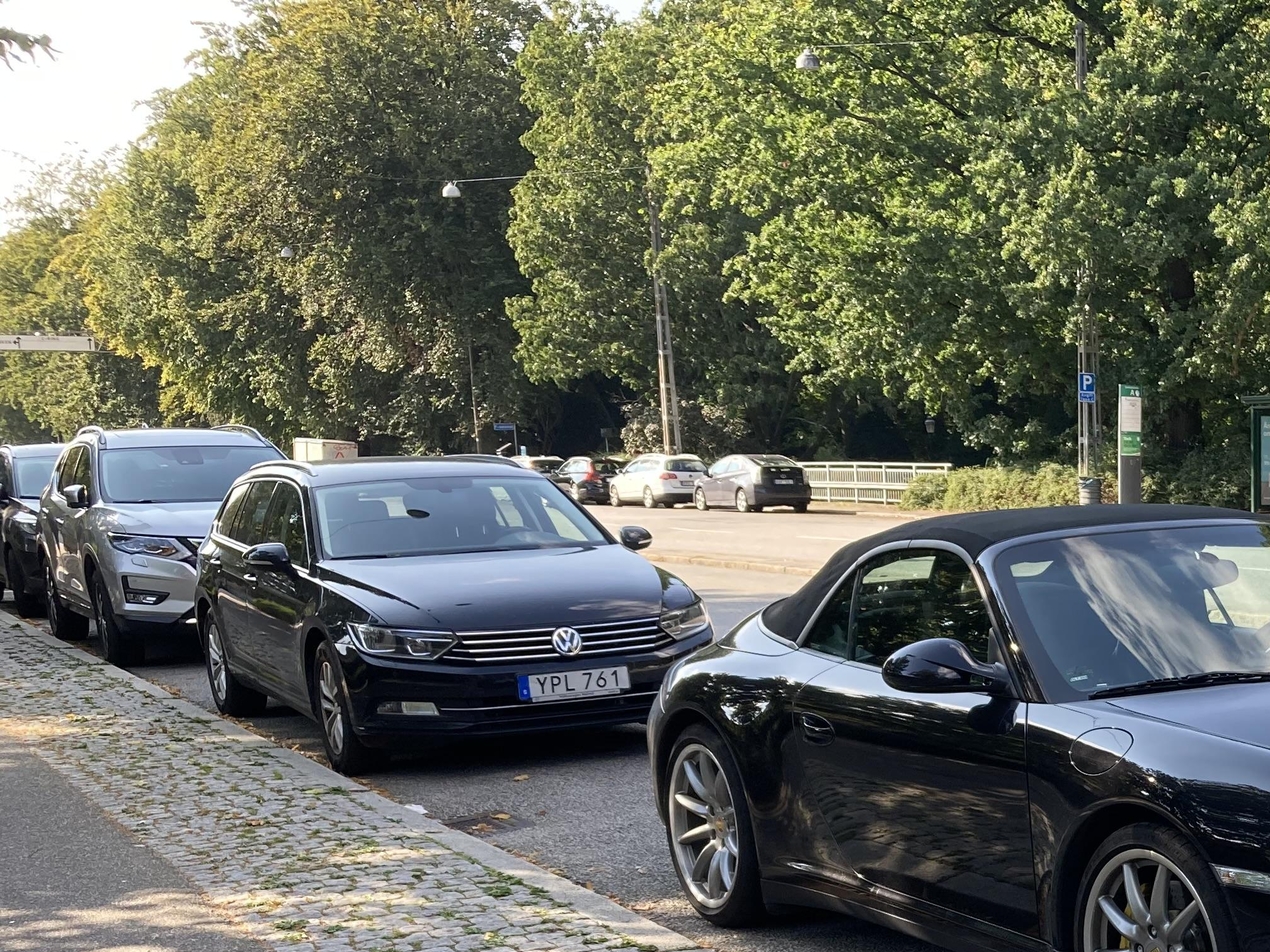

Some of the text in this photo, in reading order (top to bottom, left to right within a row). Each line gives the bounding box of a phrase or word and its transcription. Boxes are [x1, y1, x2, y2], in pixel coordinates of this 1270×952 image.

[1083, 375, 1093, 390] P
[536, 674, 576, 694] YPL
[582, 669, 619, 690] 761
